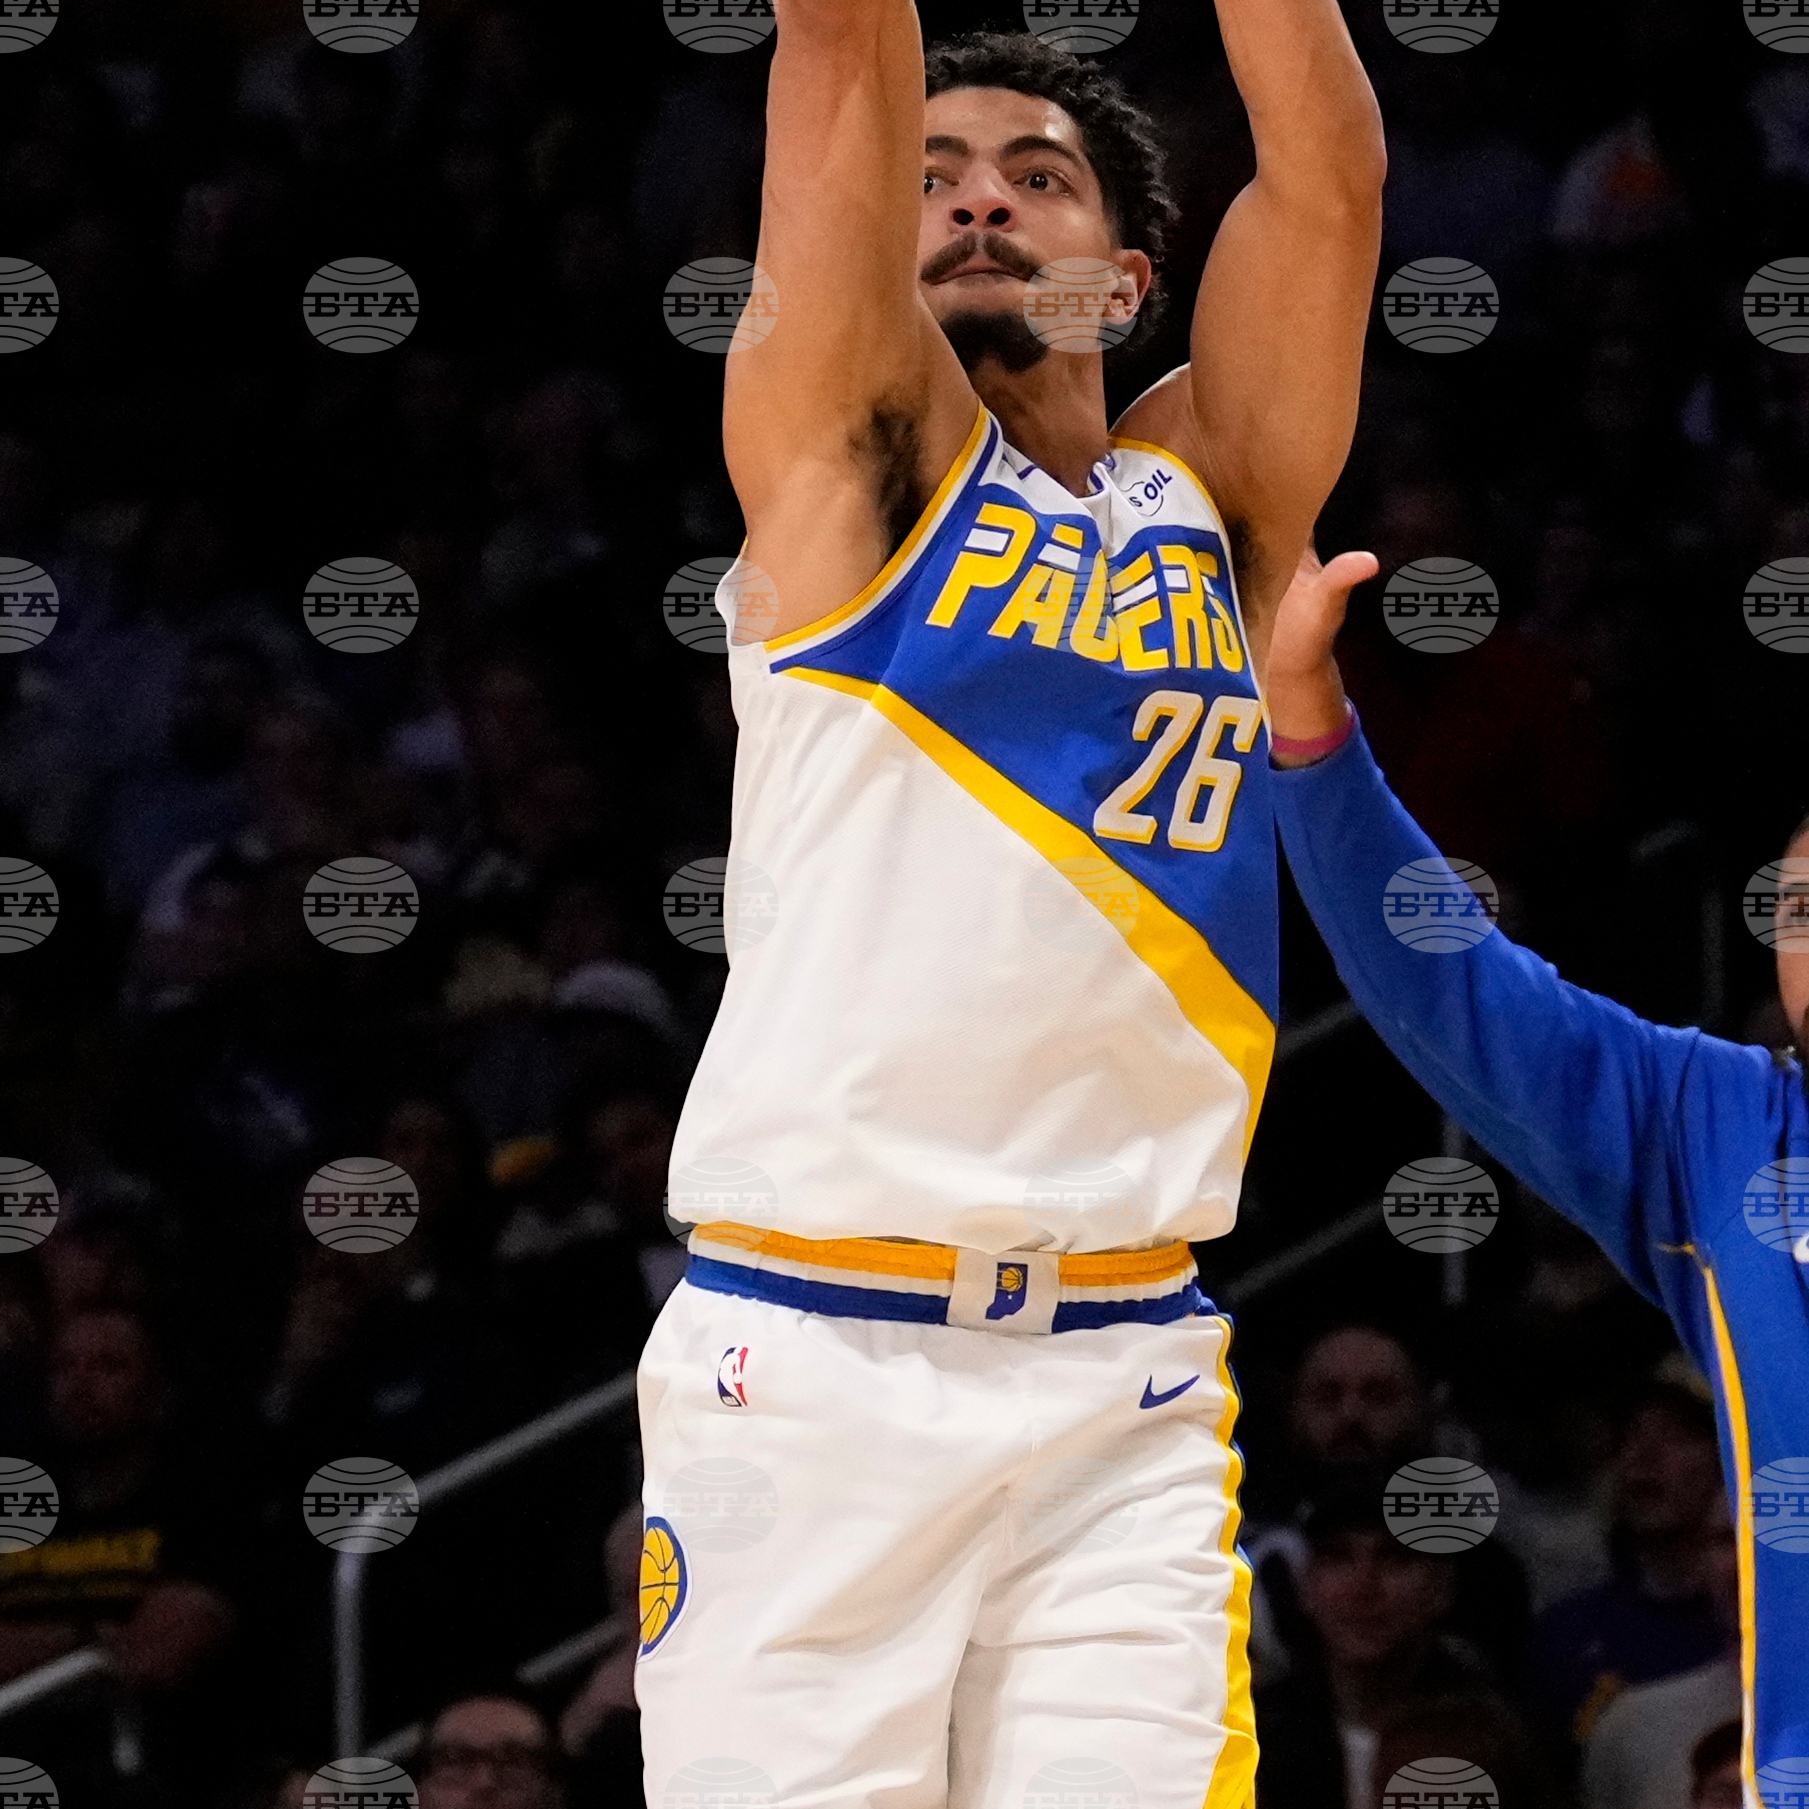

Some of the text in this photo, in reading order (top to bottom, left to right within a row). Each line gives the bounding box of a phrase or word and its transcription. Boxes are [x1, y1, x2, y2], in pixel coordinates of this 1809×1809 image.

[1143, 468, 1173, 500] OIL
[925, 501, 1245, 674] PACERS
[1093, 689, 1263, 853] 26
